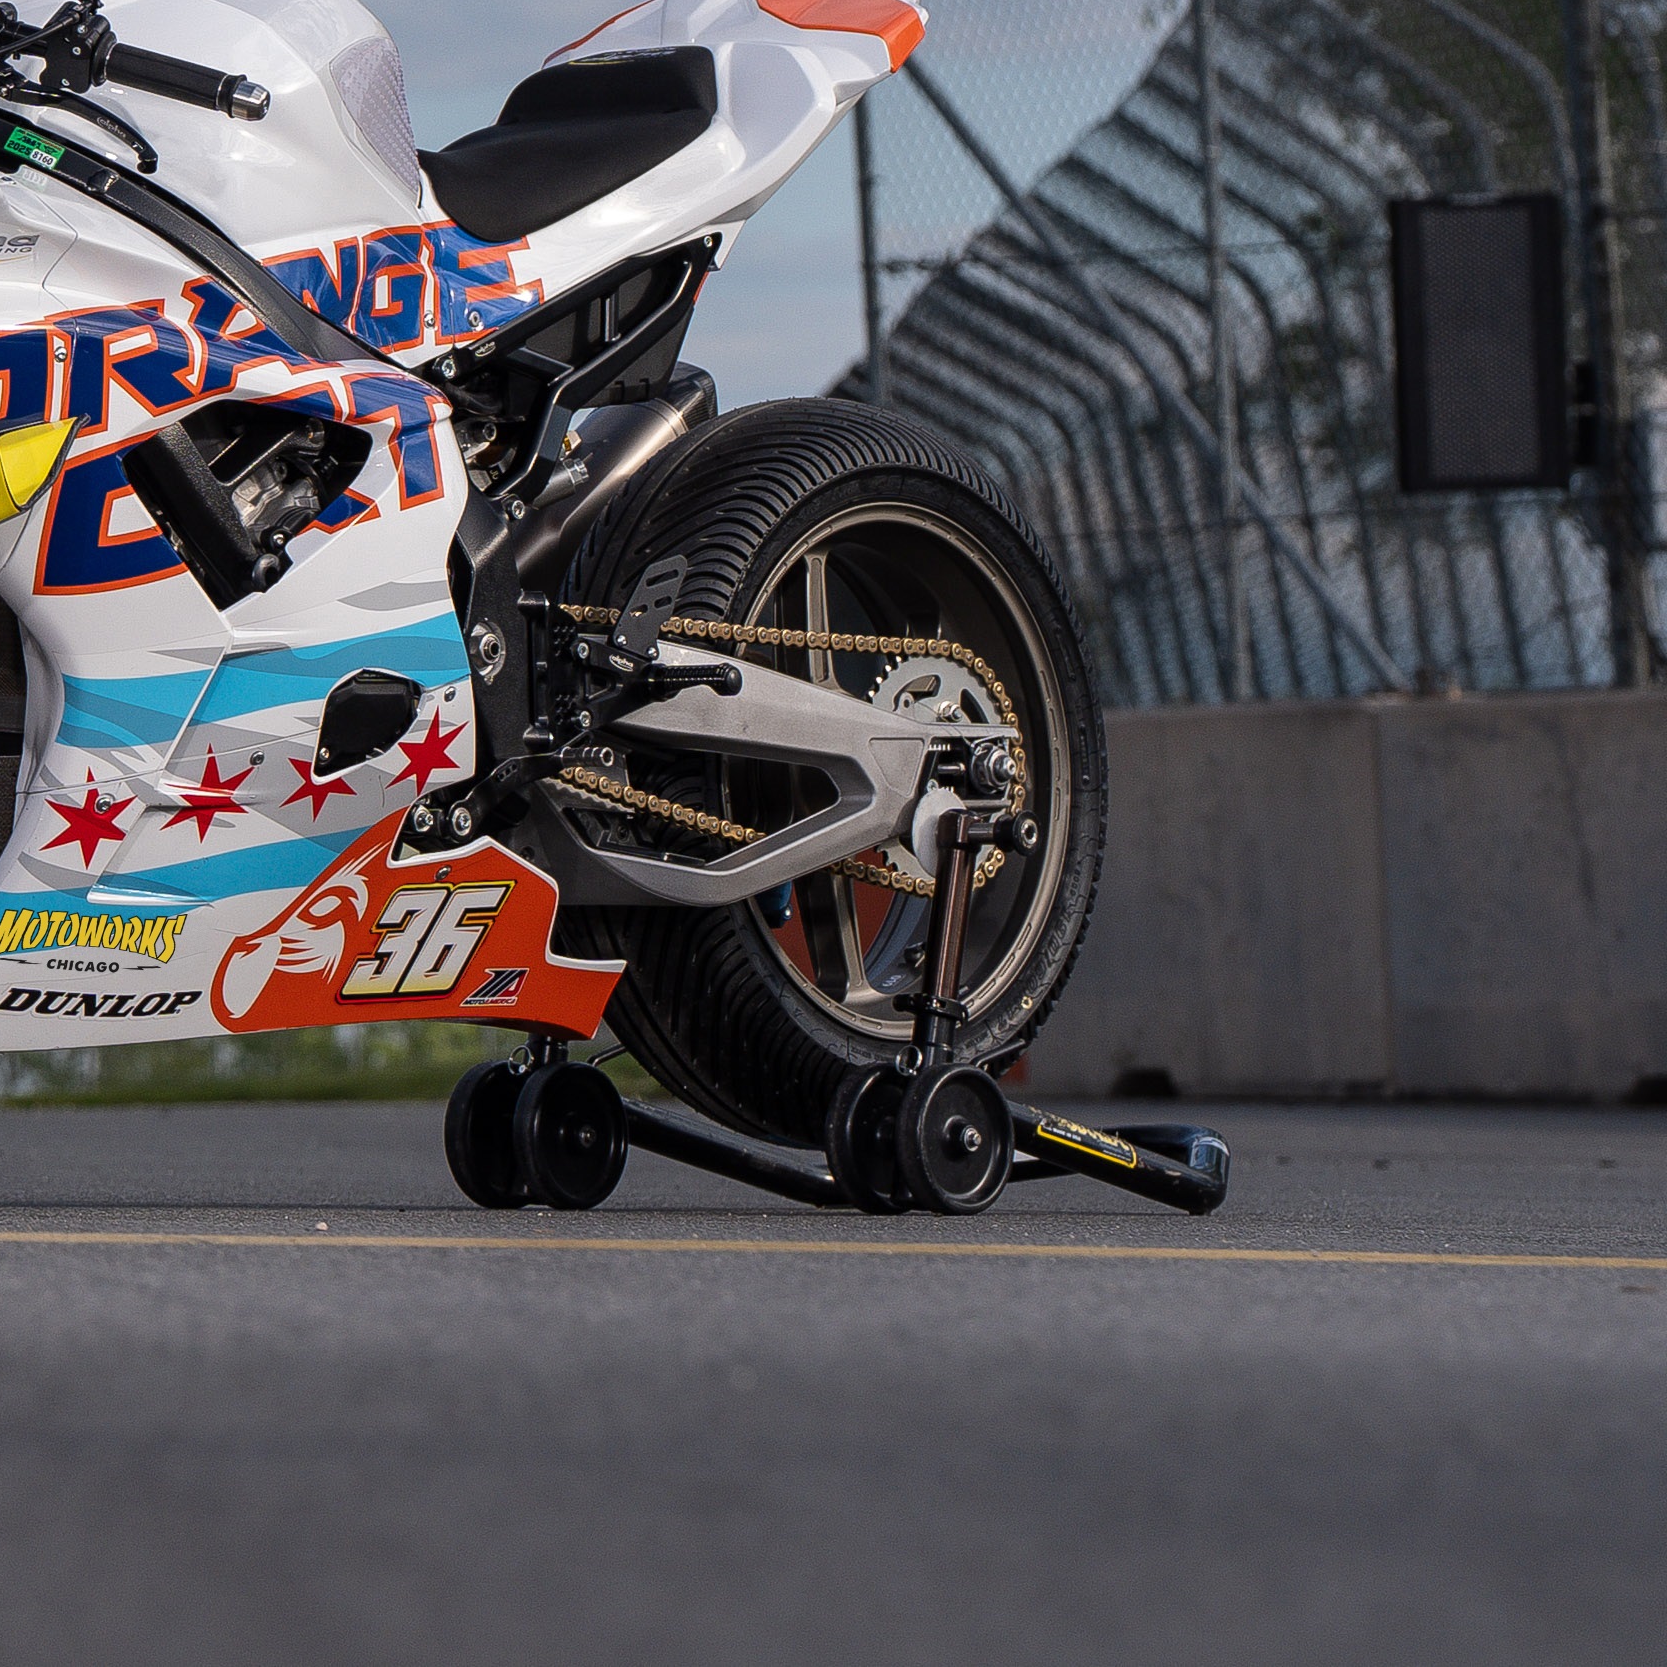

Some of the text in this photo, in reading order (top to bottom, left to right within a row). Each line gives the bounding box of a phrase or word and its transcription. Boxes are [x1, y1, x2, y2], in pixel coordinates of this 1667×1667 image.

[7, 140, 31, 156] 2025
[32, 151, 54, 165] 8160
[335, 880, 517, 1005] 36
[46, 958, 120, 973] CHICAGO
[463, 998, 517, 1006] MOTOAMERICA
